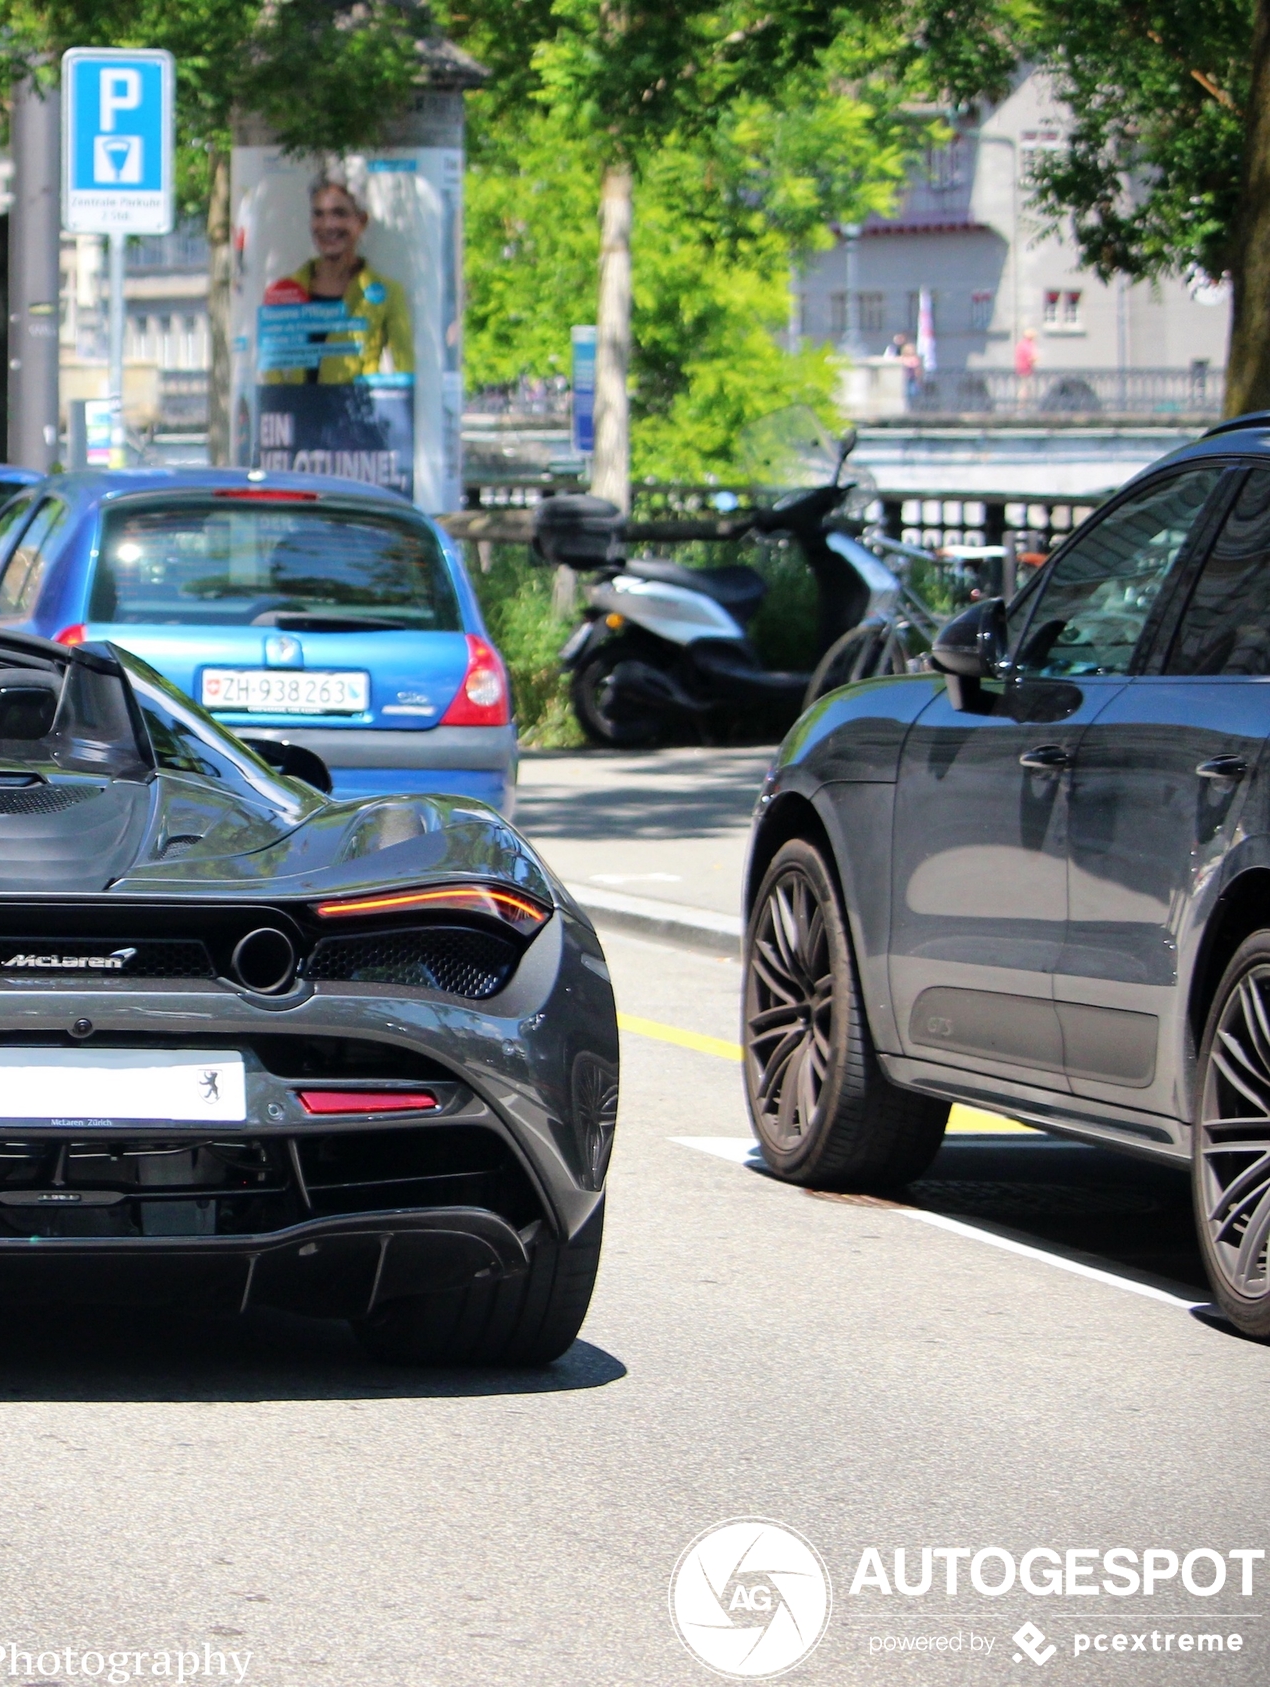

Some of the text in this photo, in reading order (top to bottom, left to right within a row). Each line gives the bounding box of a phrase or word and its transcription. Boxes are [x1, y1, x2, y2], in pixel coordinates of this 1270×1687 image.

[99, 67, 142, 132] P
[260, 413, 292, 447] EIN
[2, 954, 124, 968] McLaren
[51, 1118, 112, 1127] McLaren Zürich
